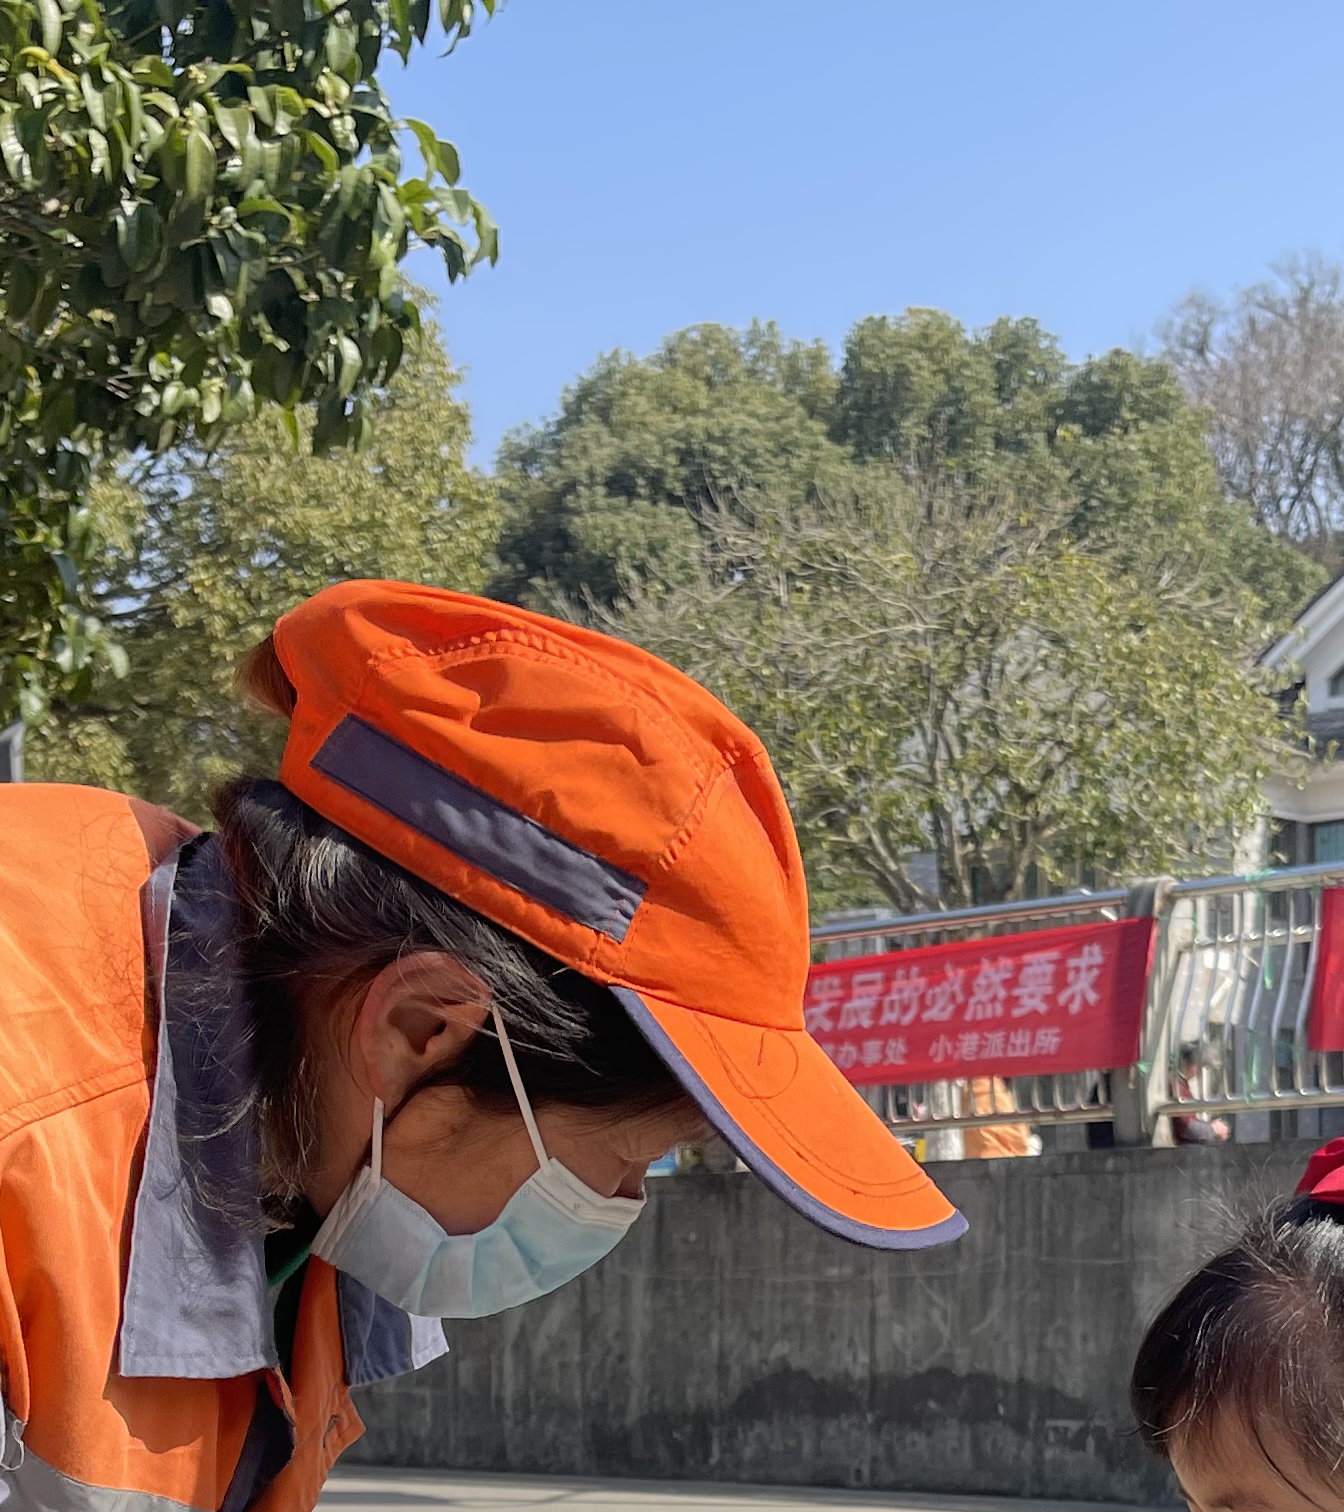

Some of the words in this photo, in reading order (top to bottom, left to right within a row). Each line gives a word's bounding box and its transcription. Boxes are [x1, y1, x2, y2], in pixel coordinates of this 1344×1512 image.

[928, 1026, 1061, 1063] 小港派出所
